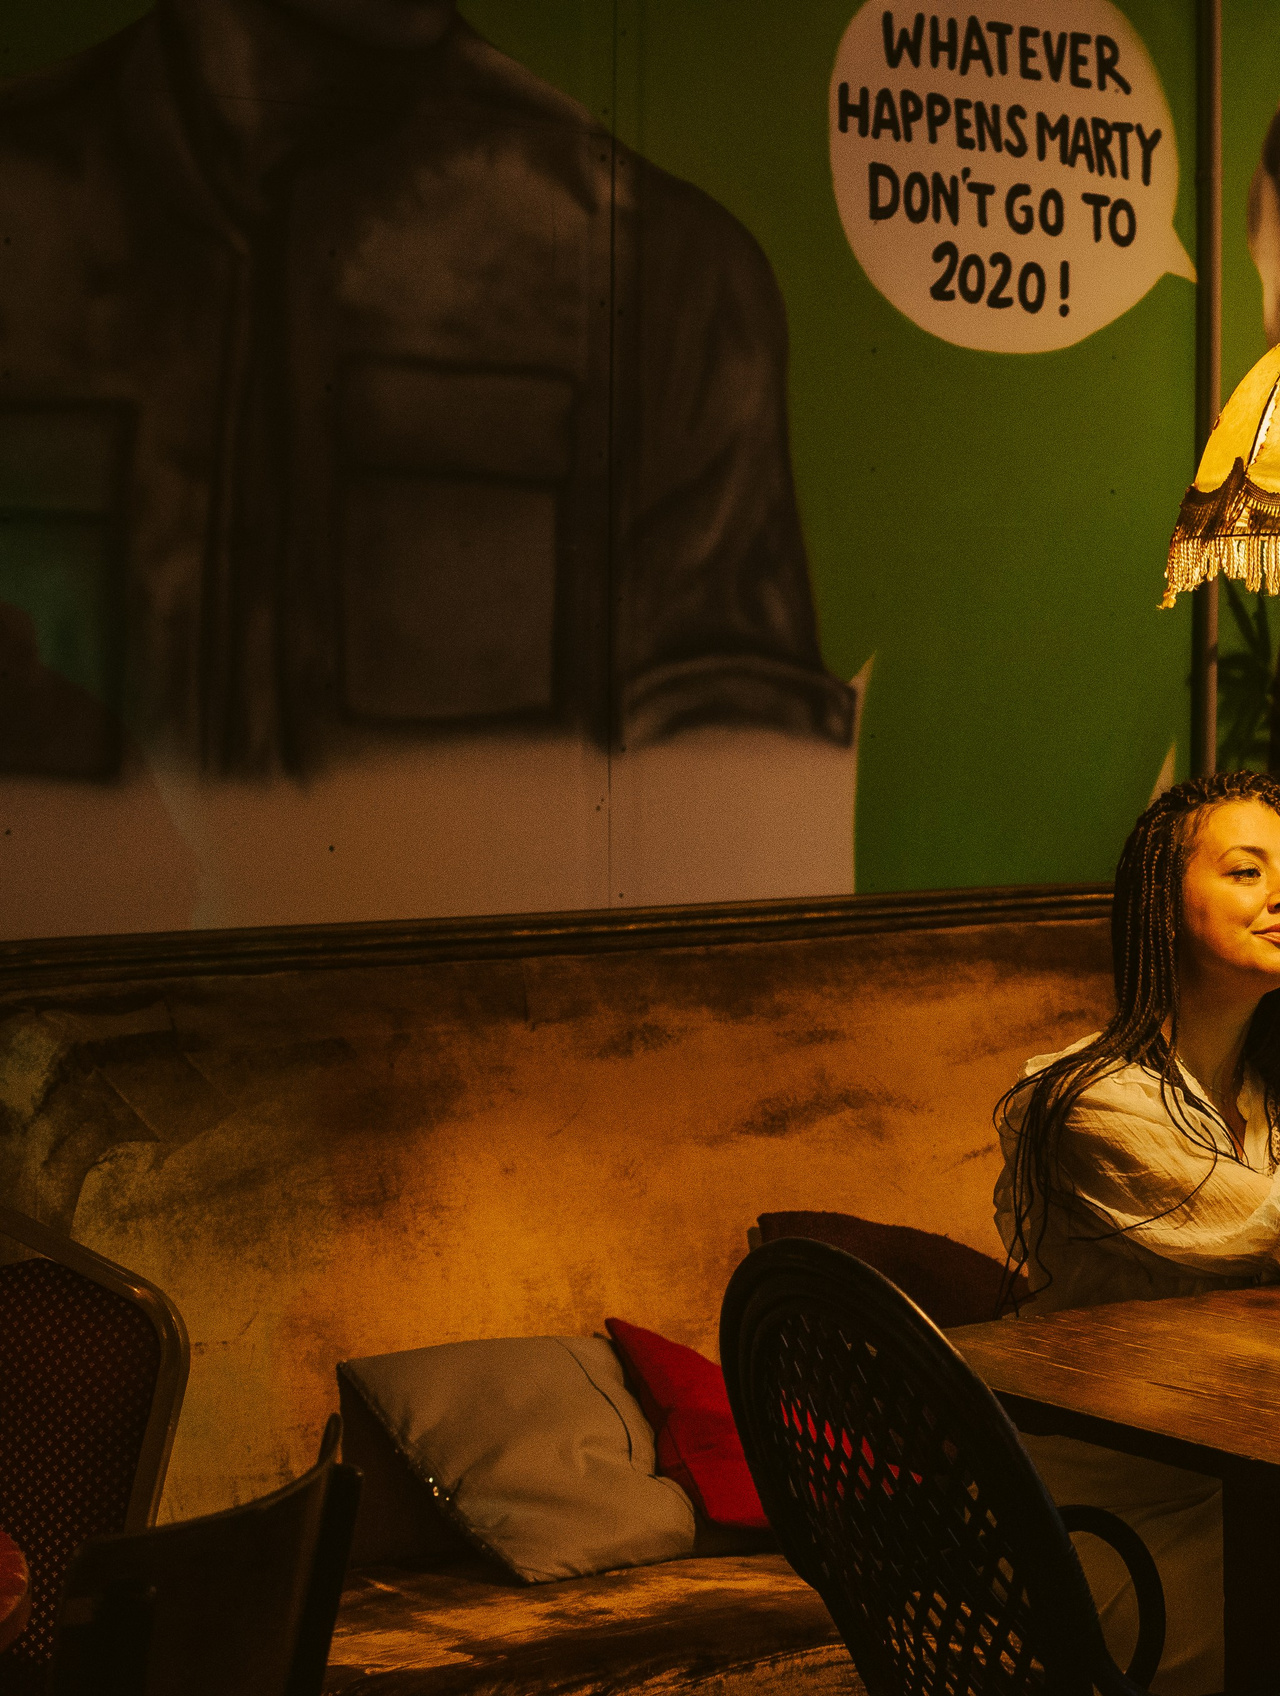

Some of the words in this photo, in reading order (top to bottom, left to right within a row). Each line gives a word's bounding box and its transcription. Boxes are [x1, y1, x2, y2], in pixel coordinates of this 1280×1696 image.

[882, 10, 1132, 95] WHATEVER
[837, 82, 1028, 158] HAPPENS
[1036, 110, 1162, 187] MARTY
[868, 161, 995, 228] DON'T
[1004, 183, 1064, 236] GO
[1081, 193, 1136, 248] TO
